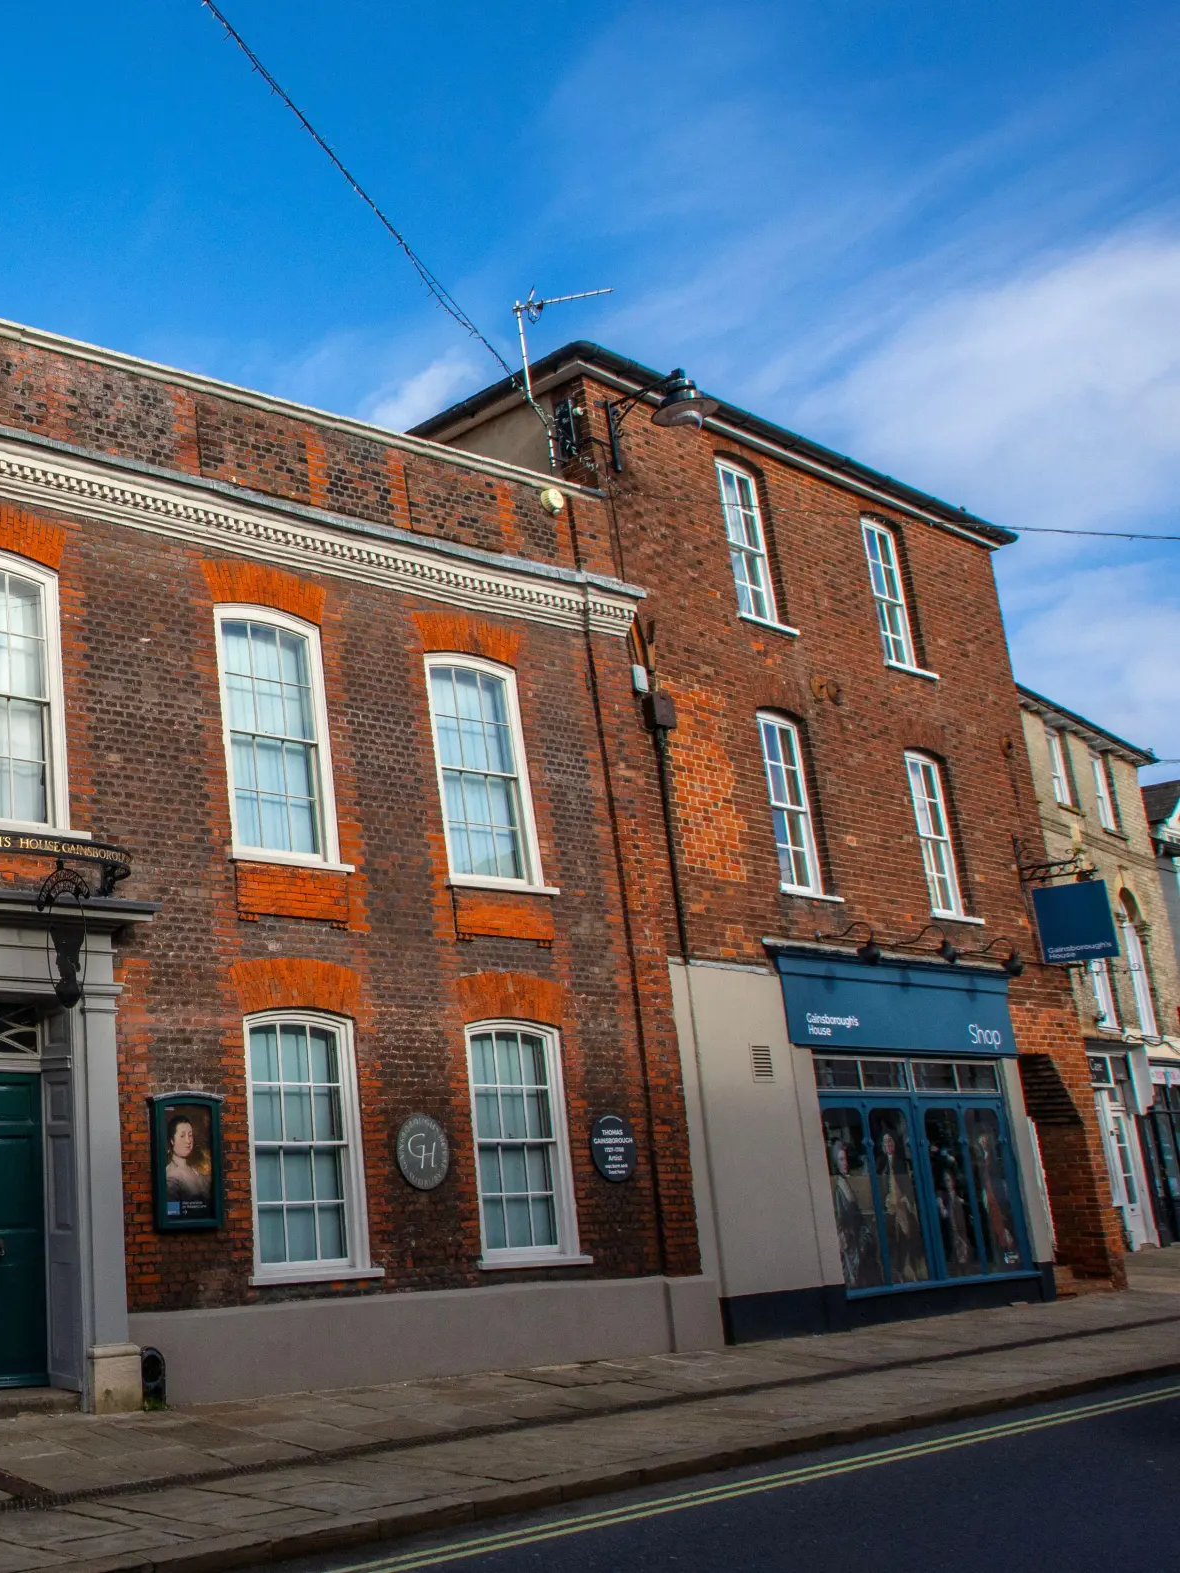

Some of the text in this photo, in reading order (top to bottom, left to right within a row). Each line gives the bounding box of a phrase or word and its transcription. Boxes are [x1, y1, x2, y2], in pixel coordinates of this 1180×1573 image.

[19, 837, 60, 853] HOUSE
[1047, 941, 1112, 954] Gainsborough's
[806, 1012, 860, 1028] Gainsborough's
[808, 1024, 832, 1036] House
[968, 1023, 1001, 1050] Shop
